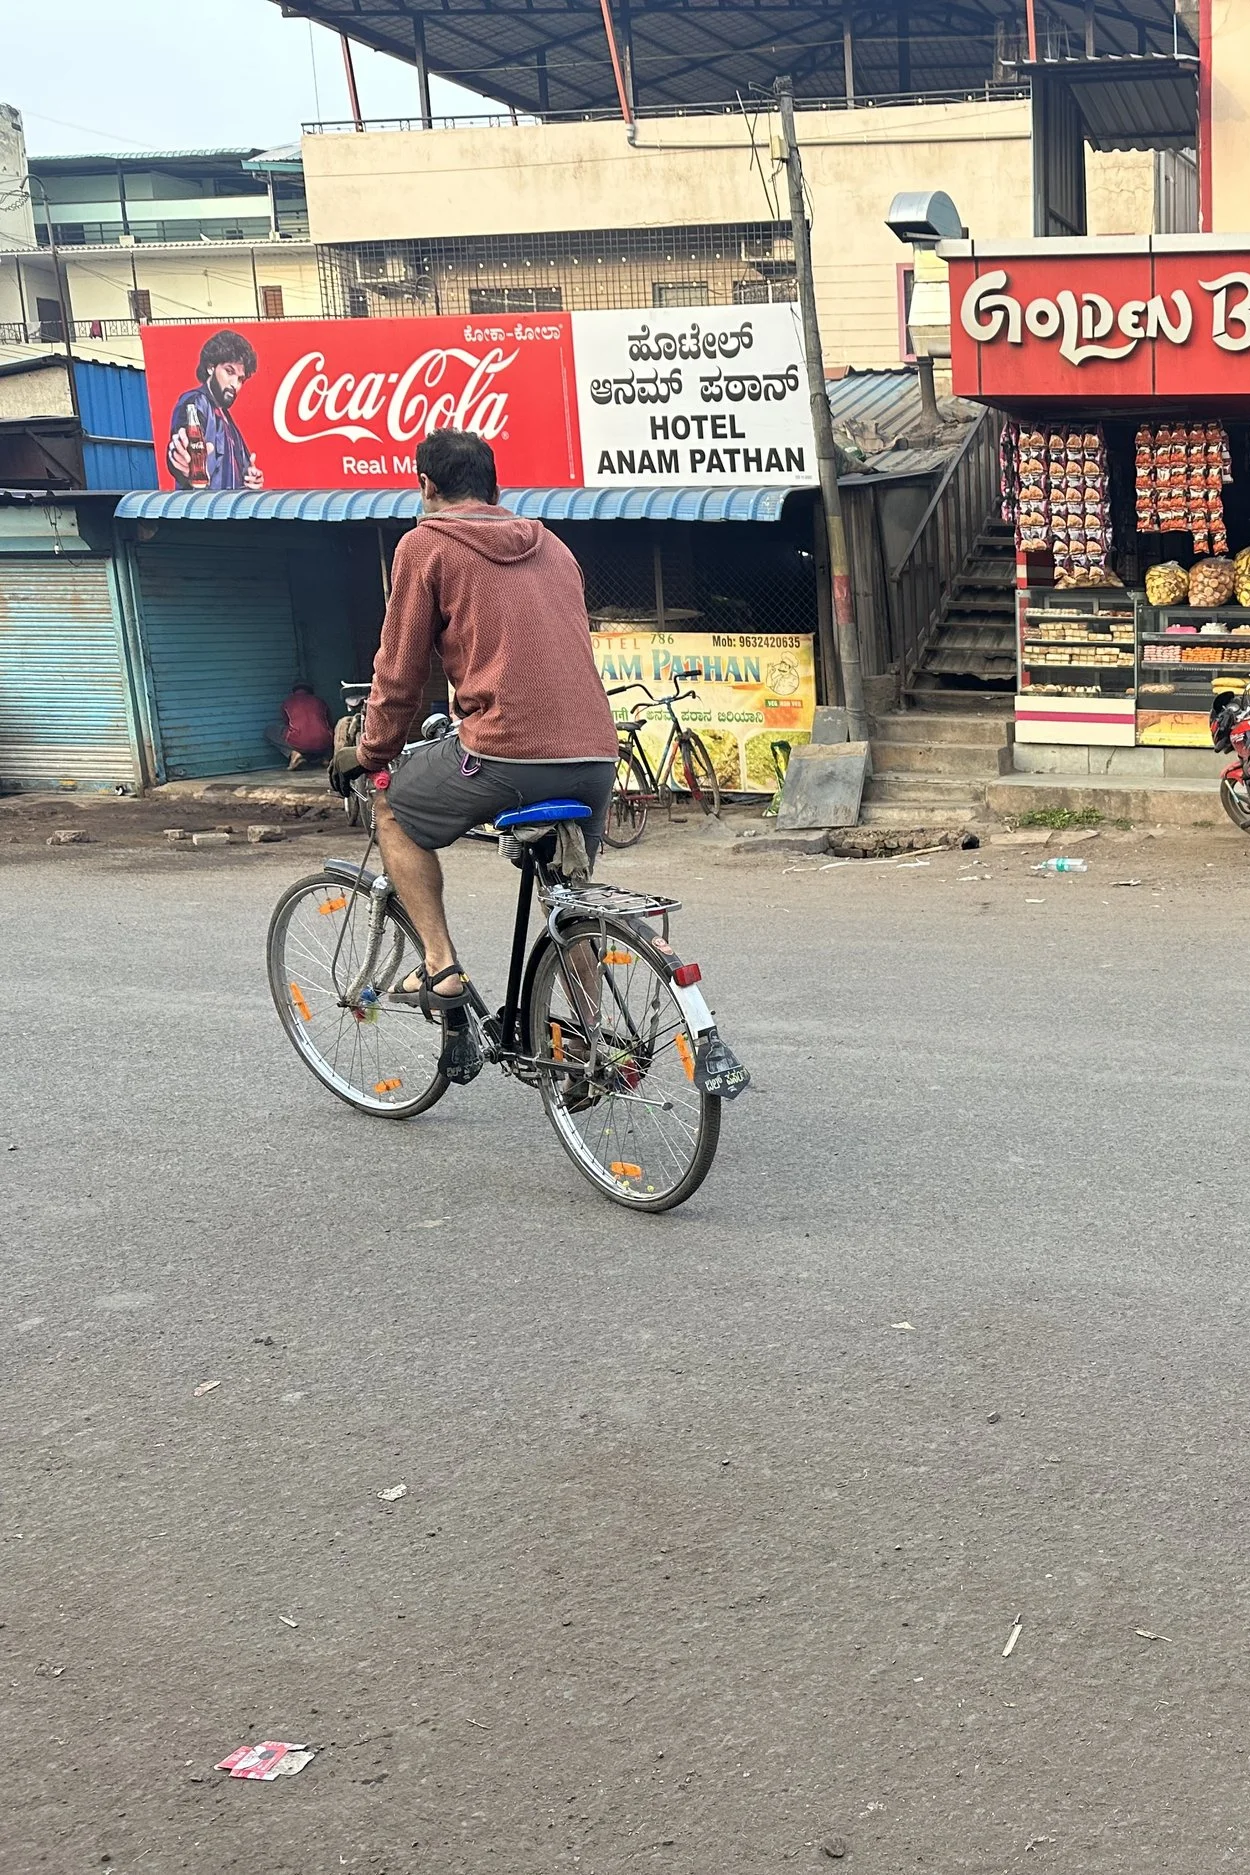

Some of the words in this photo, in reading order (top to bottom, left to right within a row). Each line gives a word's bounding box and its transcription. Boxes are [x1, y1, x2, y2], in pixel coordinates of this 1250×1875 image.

[960, 269, 1193, 367] GOLDEN
[273, 347, 520, 443] Coca-Cola
[650, 414, 746, 440] HOTEL
[343, 455, 388, 474] Real
[597, 449, 680, 474] ANAM
[689, 447, 805, 473] PATHAN
[592, 638, 641, 650] OTEL
[650, 634, 674, 645] 786
[712, 635, 736, 648] Mob:
[739, 635, 801, 648] 9632420635
[652, 649, 762, 682] PATHAN
